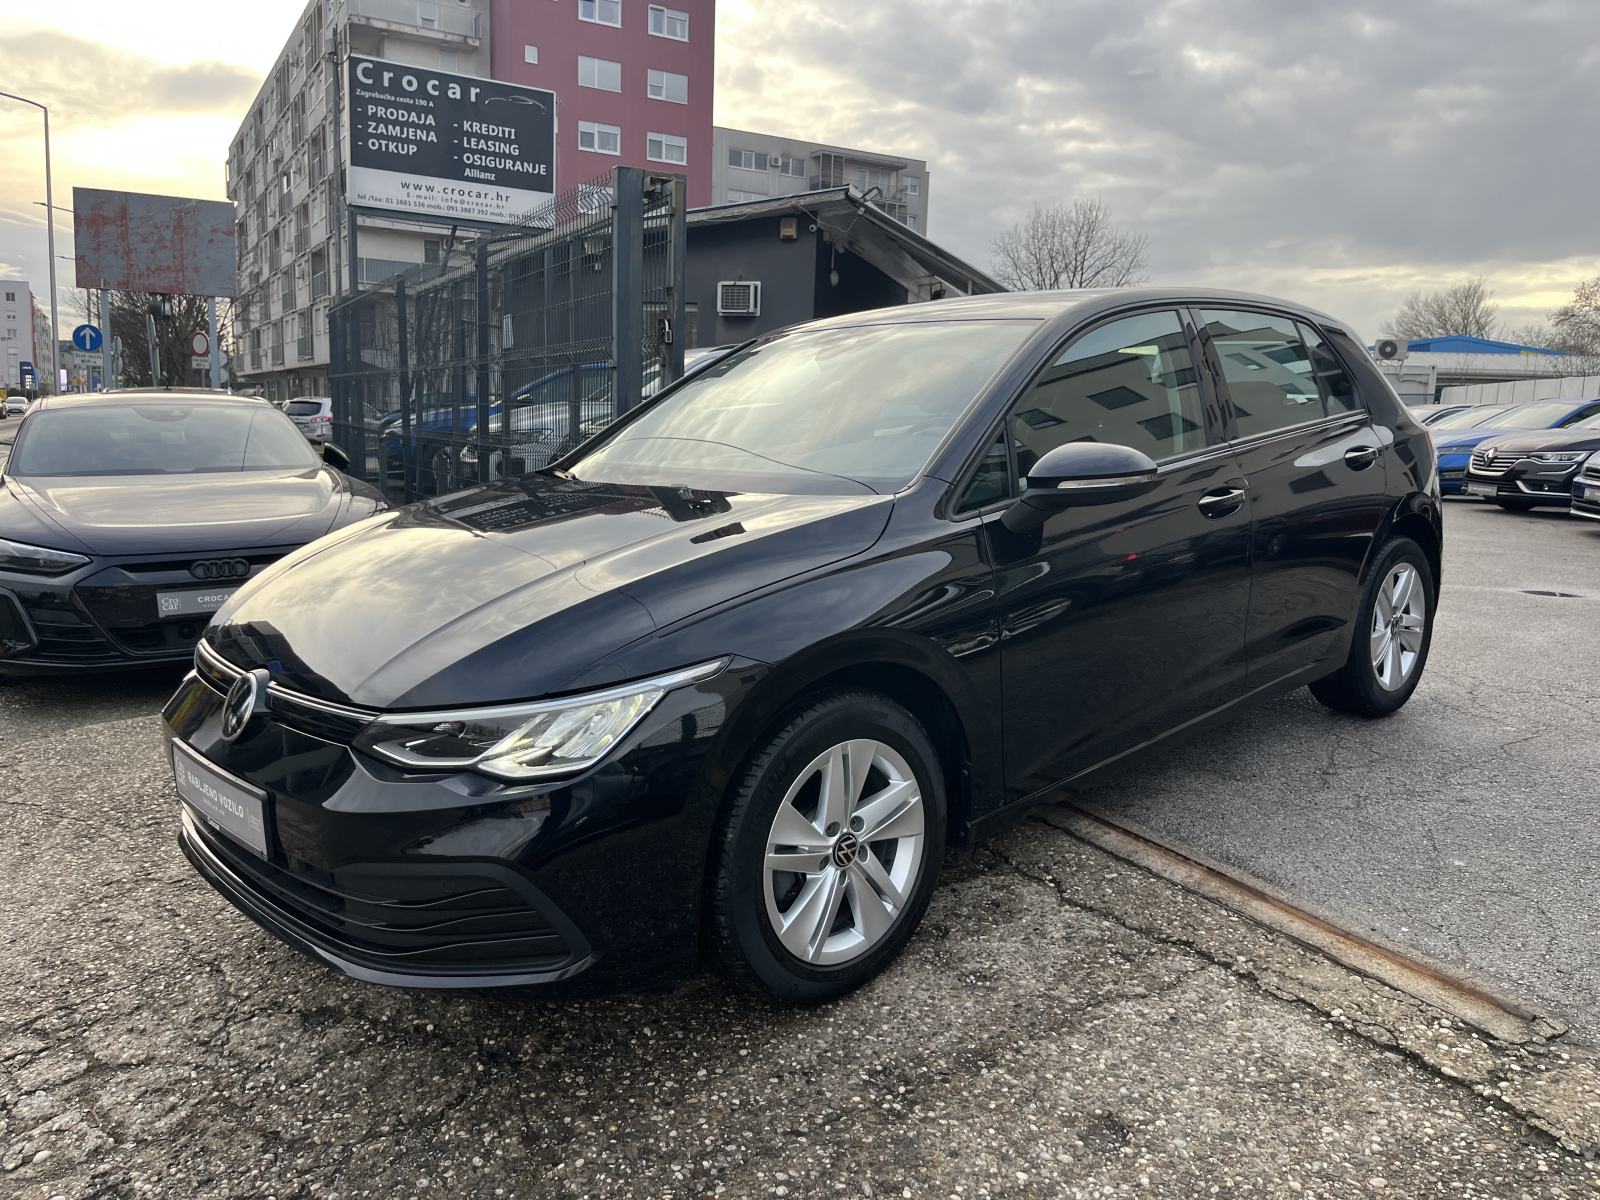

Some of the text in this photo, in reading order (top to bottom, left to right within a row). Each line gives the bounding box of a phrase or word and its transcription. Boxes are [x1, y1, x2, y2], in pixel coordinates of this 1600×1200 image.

[356, 62, 480, 103] Crocar
[396, 96, 414, 105] cesta
[415, 98, 427, 107] 190
[368, 105, 436, 126] PRODAJA
[368, 122, 438, 143] ZAMJENA
[463, 121, 516, 139] KREDITI
[368, 139, 418, 156] OTKUP
[463, 137, 520, 156] LEASING
[463, 153, 547, 175] OSIGURANJE
[464, 168, 496, 181] Allianz
[400, 181, 511, 203] www.crocar.hr
[197, 594, 230, 603] CROCA
[218, 792, 244, 818] VOZILO
